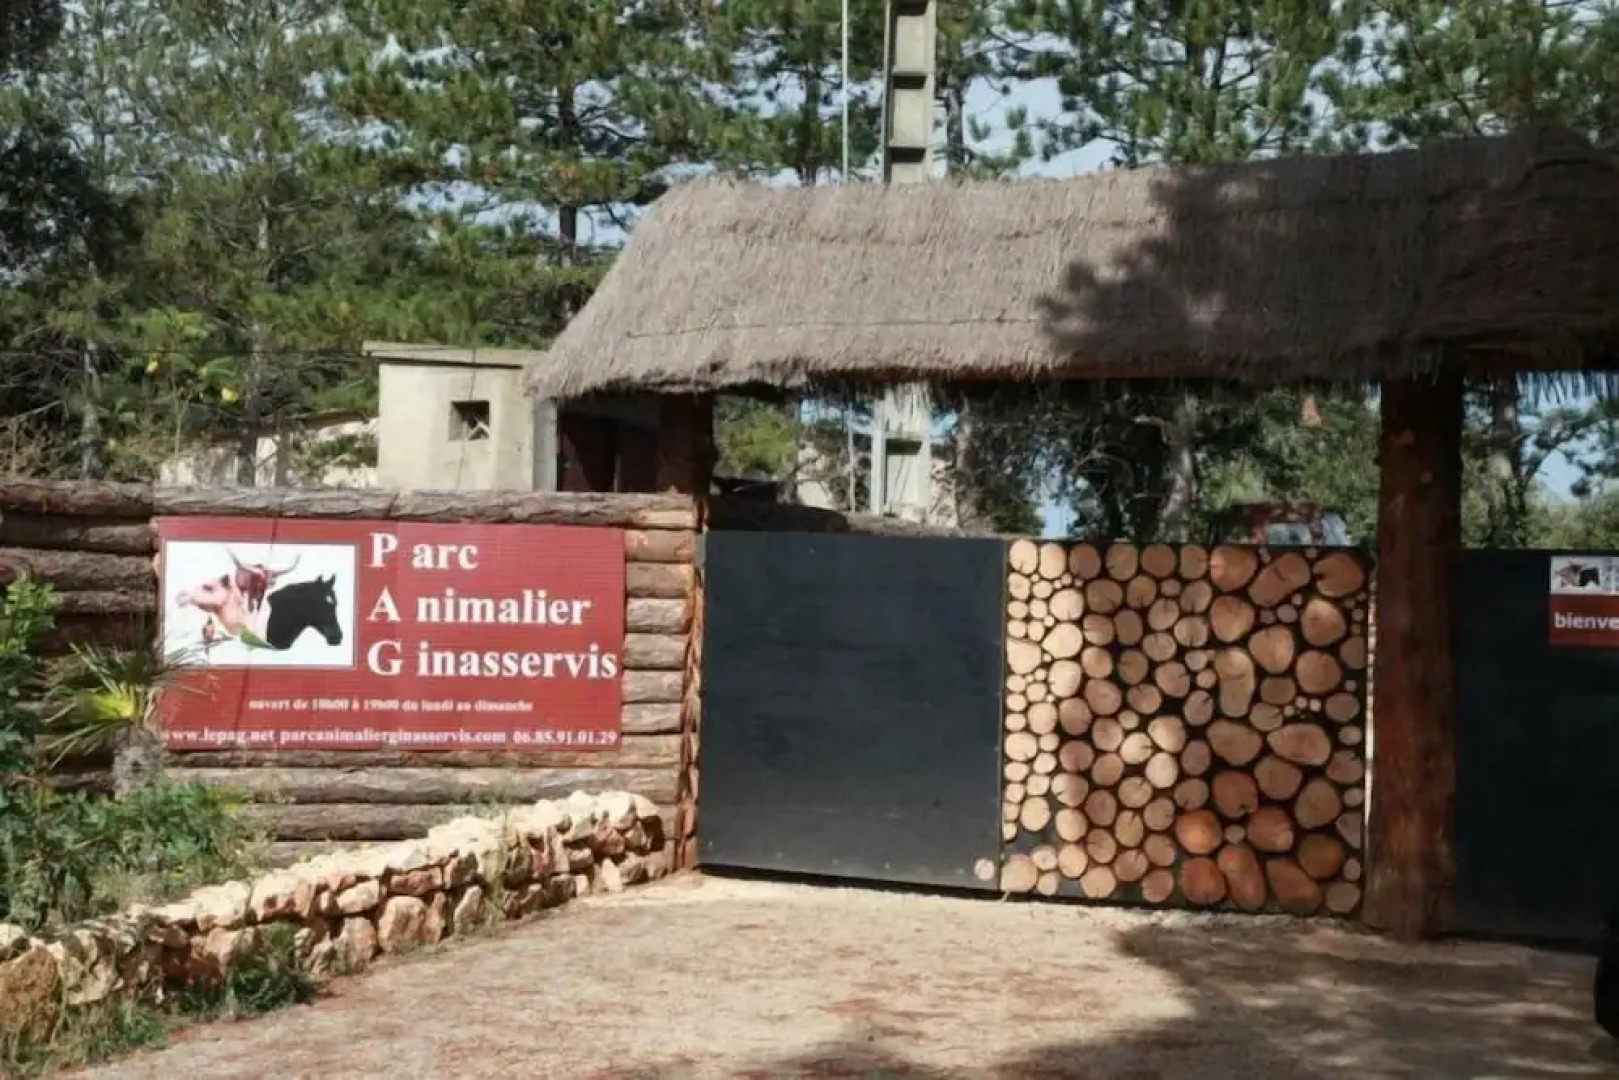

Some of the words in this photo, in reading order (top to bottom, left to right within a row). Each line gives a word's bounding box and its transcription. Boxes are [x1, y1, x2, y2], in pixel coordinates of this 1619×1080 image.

[368, 532, 397, 568] P
[412, 544, 479, 570] arc
[366, 586, 401, 623] A
[416, 588, 591, 626] nimalier
[367, 640, 403, 676] G
[417, 641, 618, 678] inasservis
[248, 699, 291, 711] ouvert
[292, 698, 308, 711] de
[402, 699, 418, 712] du
[421, 699, 453, 712] lundi
[475, 699, 533, 712] dimanche
[280, 728, 506, 746] parcanimalierginasservis.com
